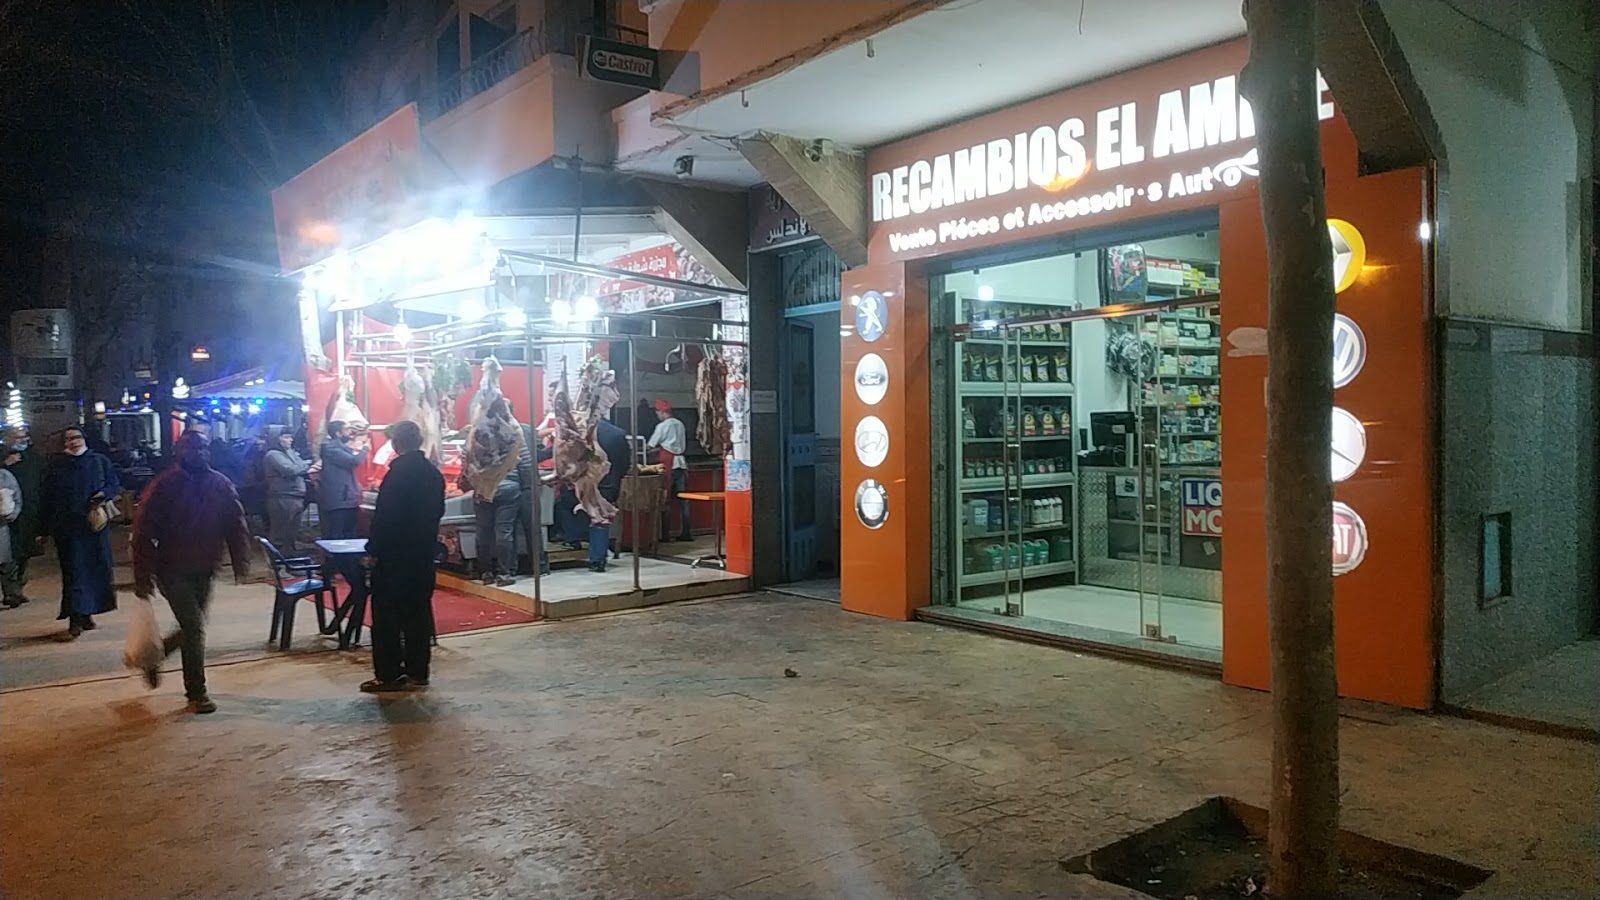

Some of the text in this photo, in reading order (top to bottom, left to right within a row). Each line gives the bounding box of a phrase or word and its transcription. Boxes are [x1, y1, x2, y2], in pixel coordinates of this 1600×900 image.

[608, 54, 651, 75] Castrol
[872, 118, 1085, 222] RECAMBIOS
[1096, 101, 1145, 171] EL
[889, 228, 937, 252] Vente
[1003, 206, 1025, 230] et
[1028, 181, 1163, 225] Accessoirs
[1184, 482, 1223, 507] LIQ
[1332, 523, 1352, 556] AT
